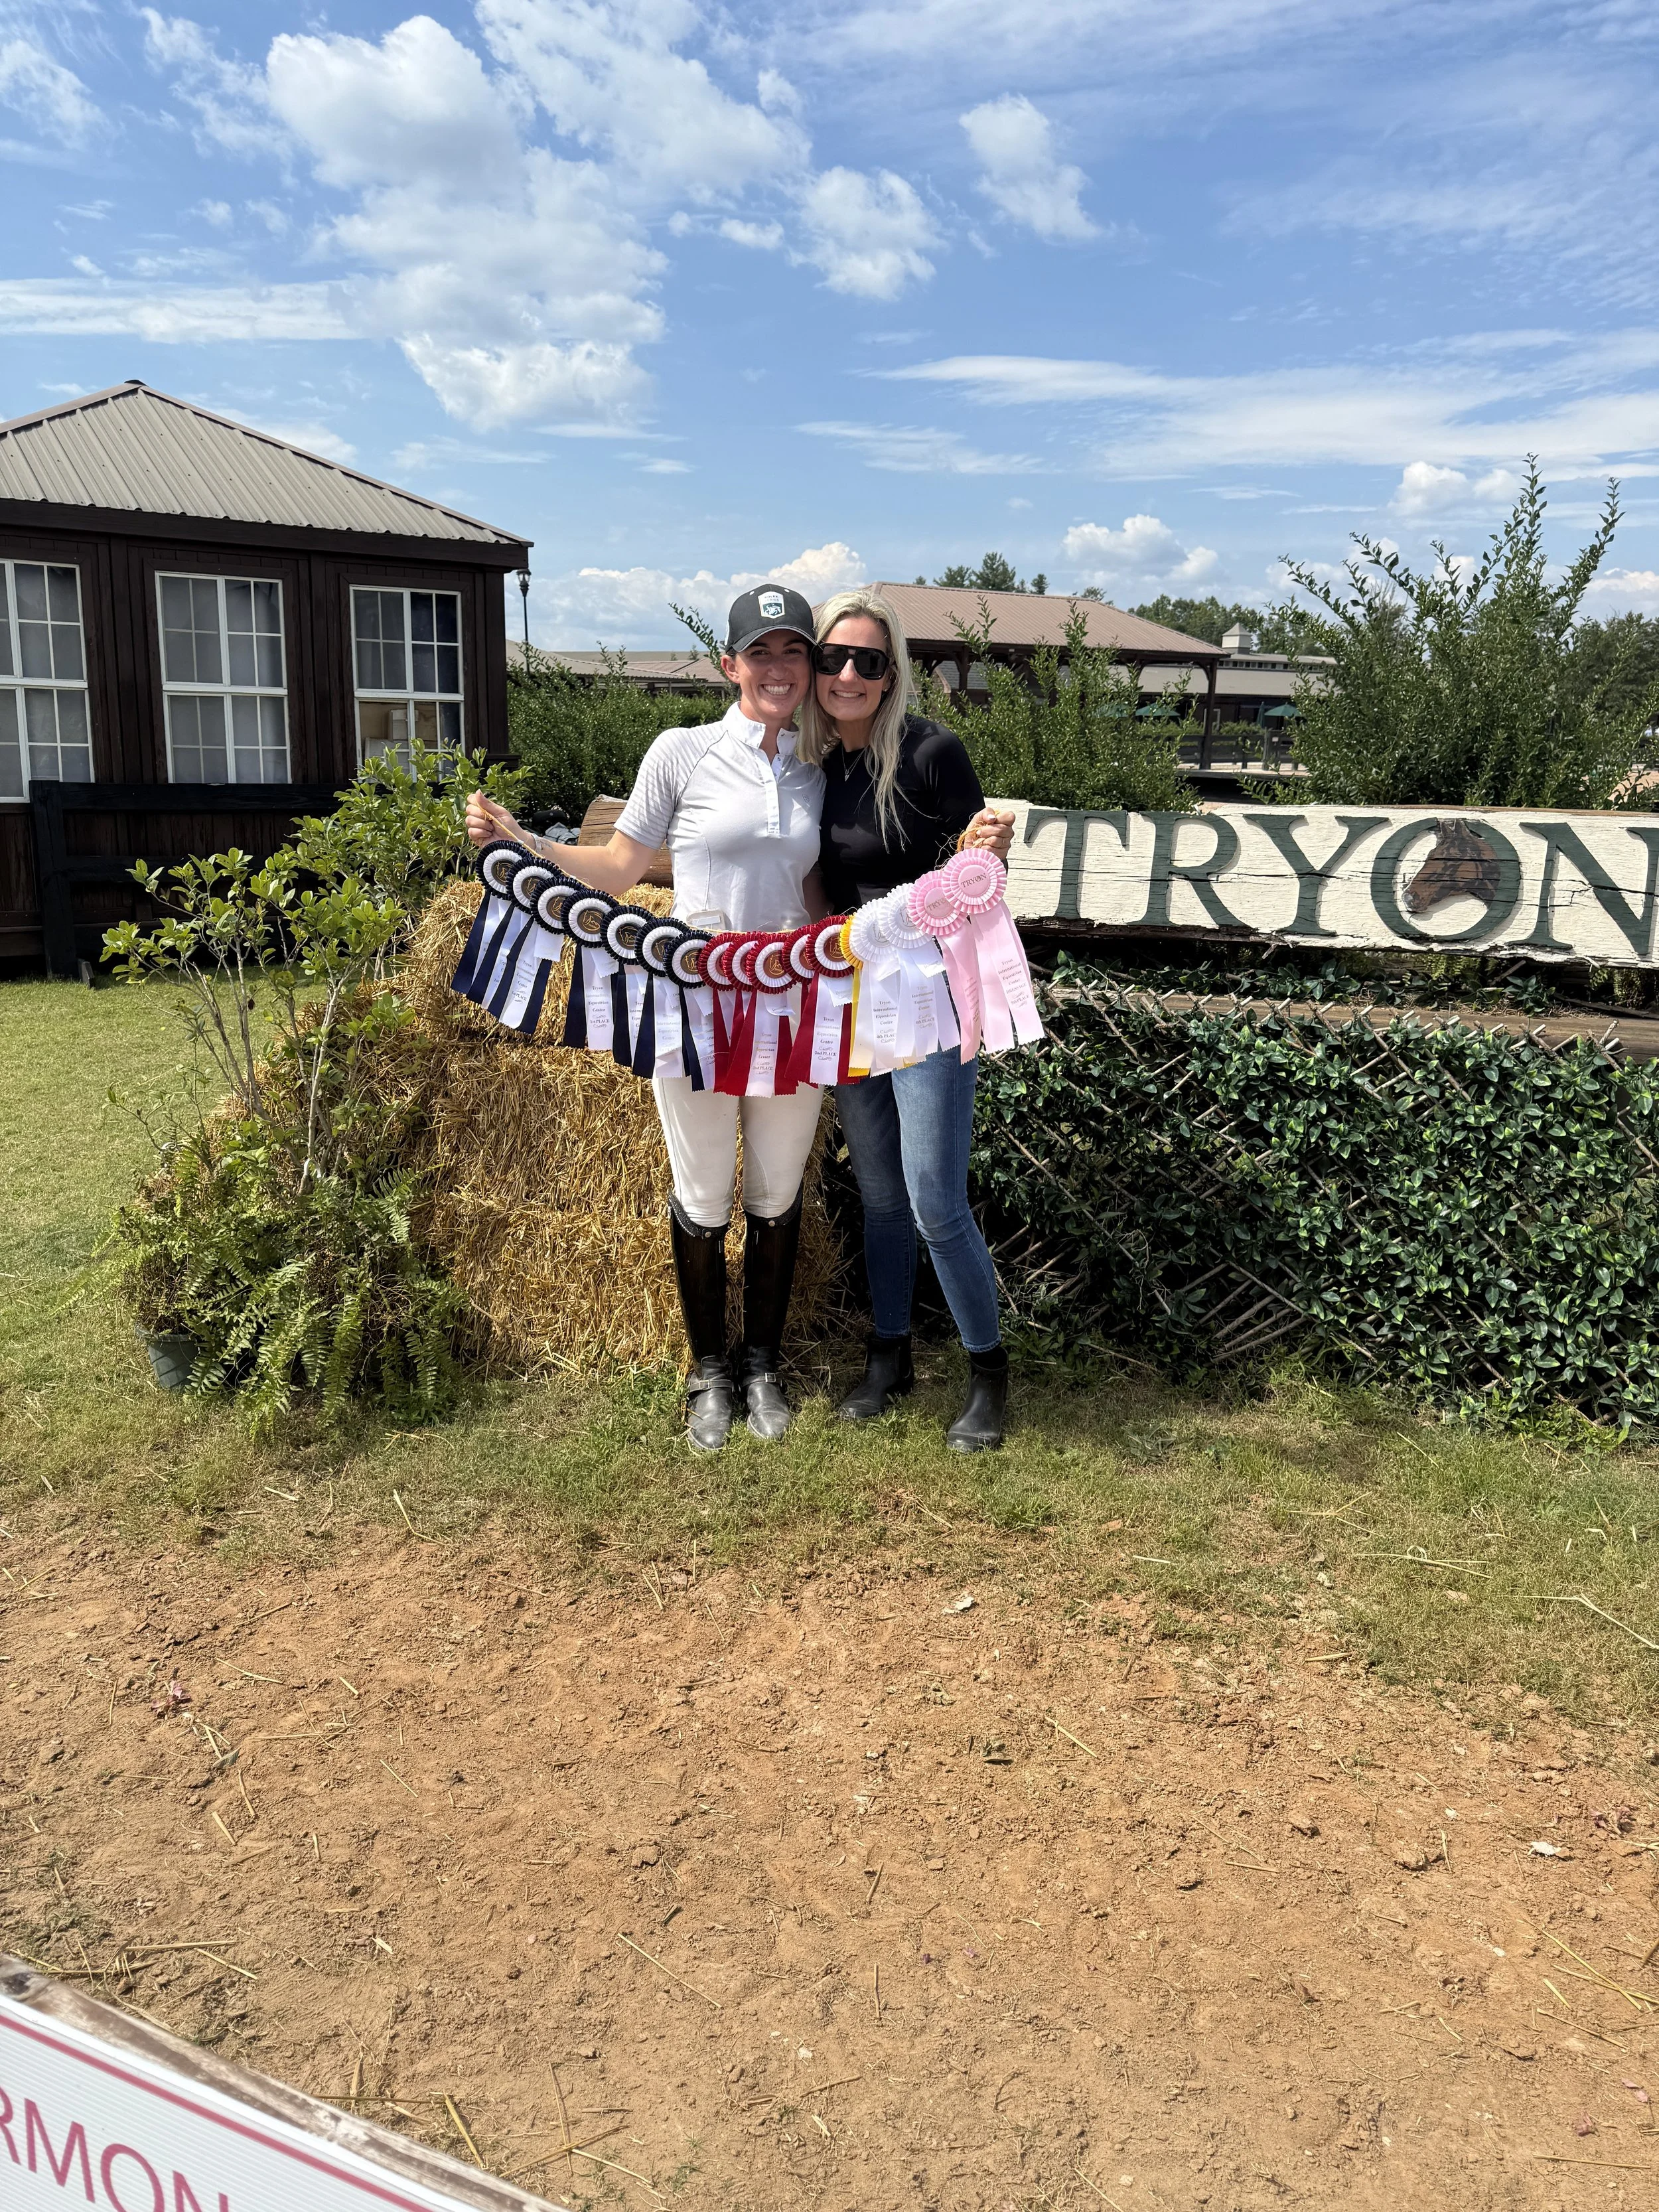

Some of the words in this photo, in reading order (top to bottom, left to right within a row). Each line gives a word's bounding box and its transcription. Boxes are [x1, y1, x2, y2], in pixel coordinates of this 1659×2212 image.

[961, 873, 987, 888] TRYON
[1024, 808, 1659, 956] TRYON
[927, 897, 947, 912] TRYO
